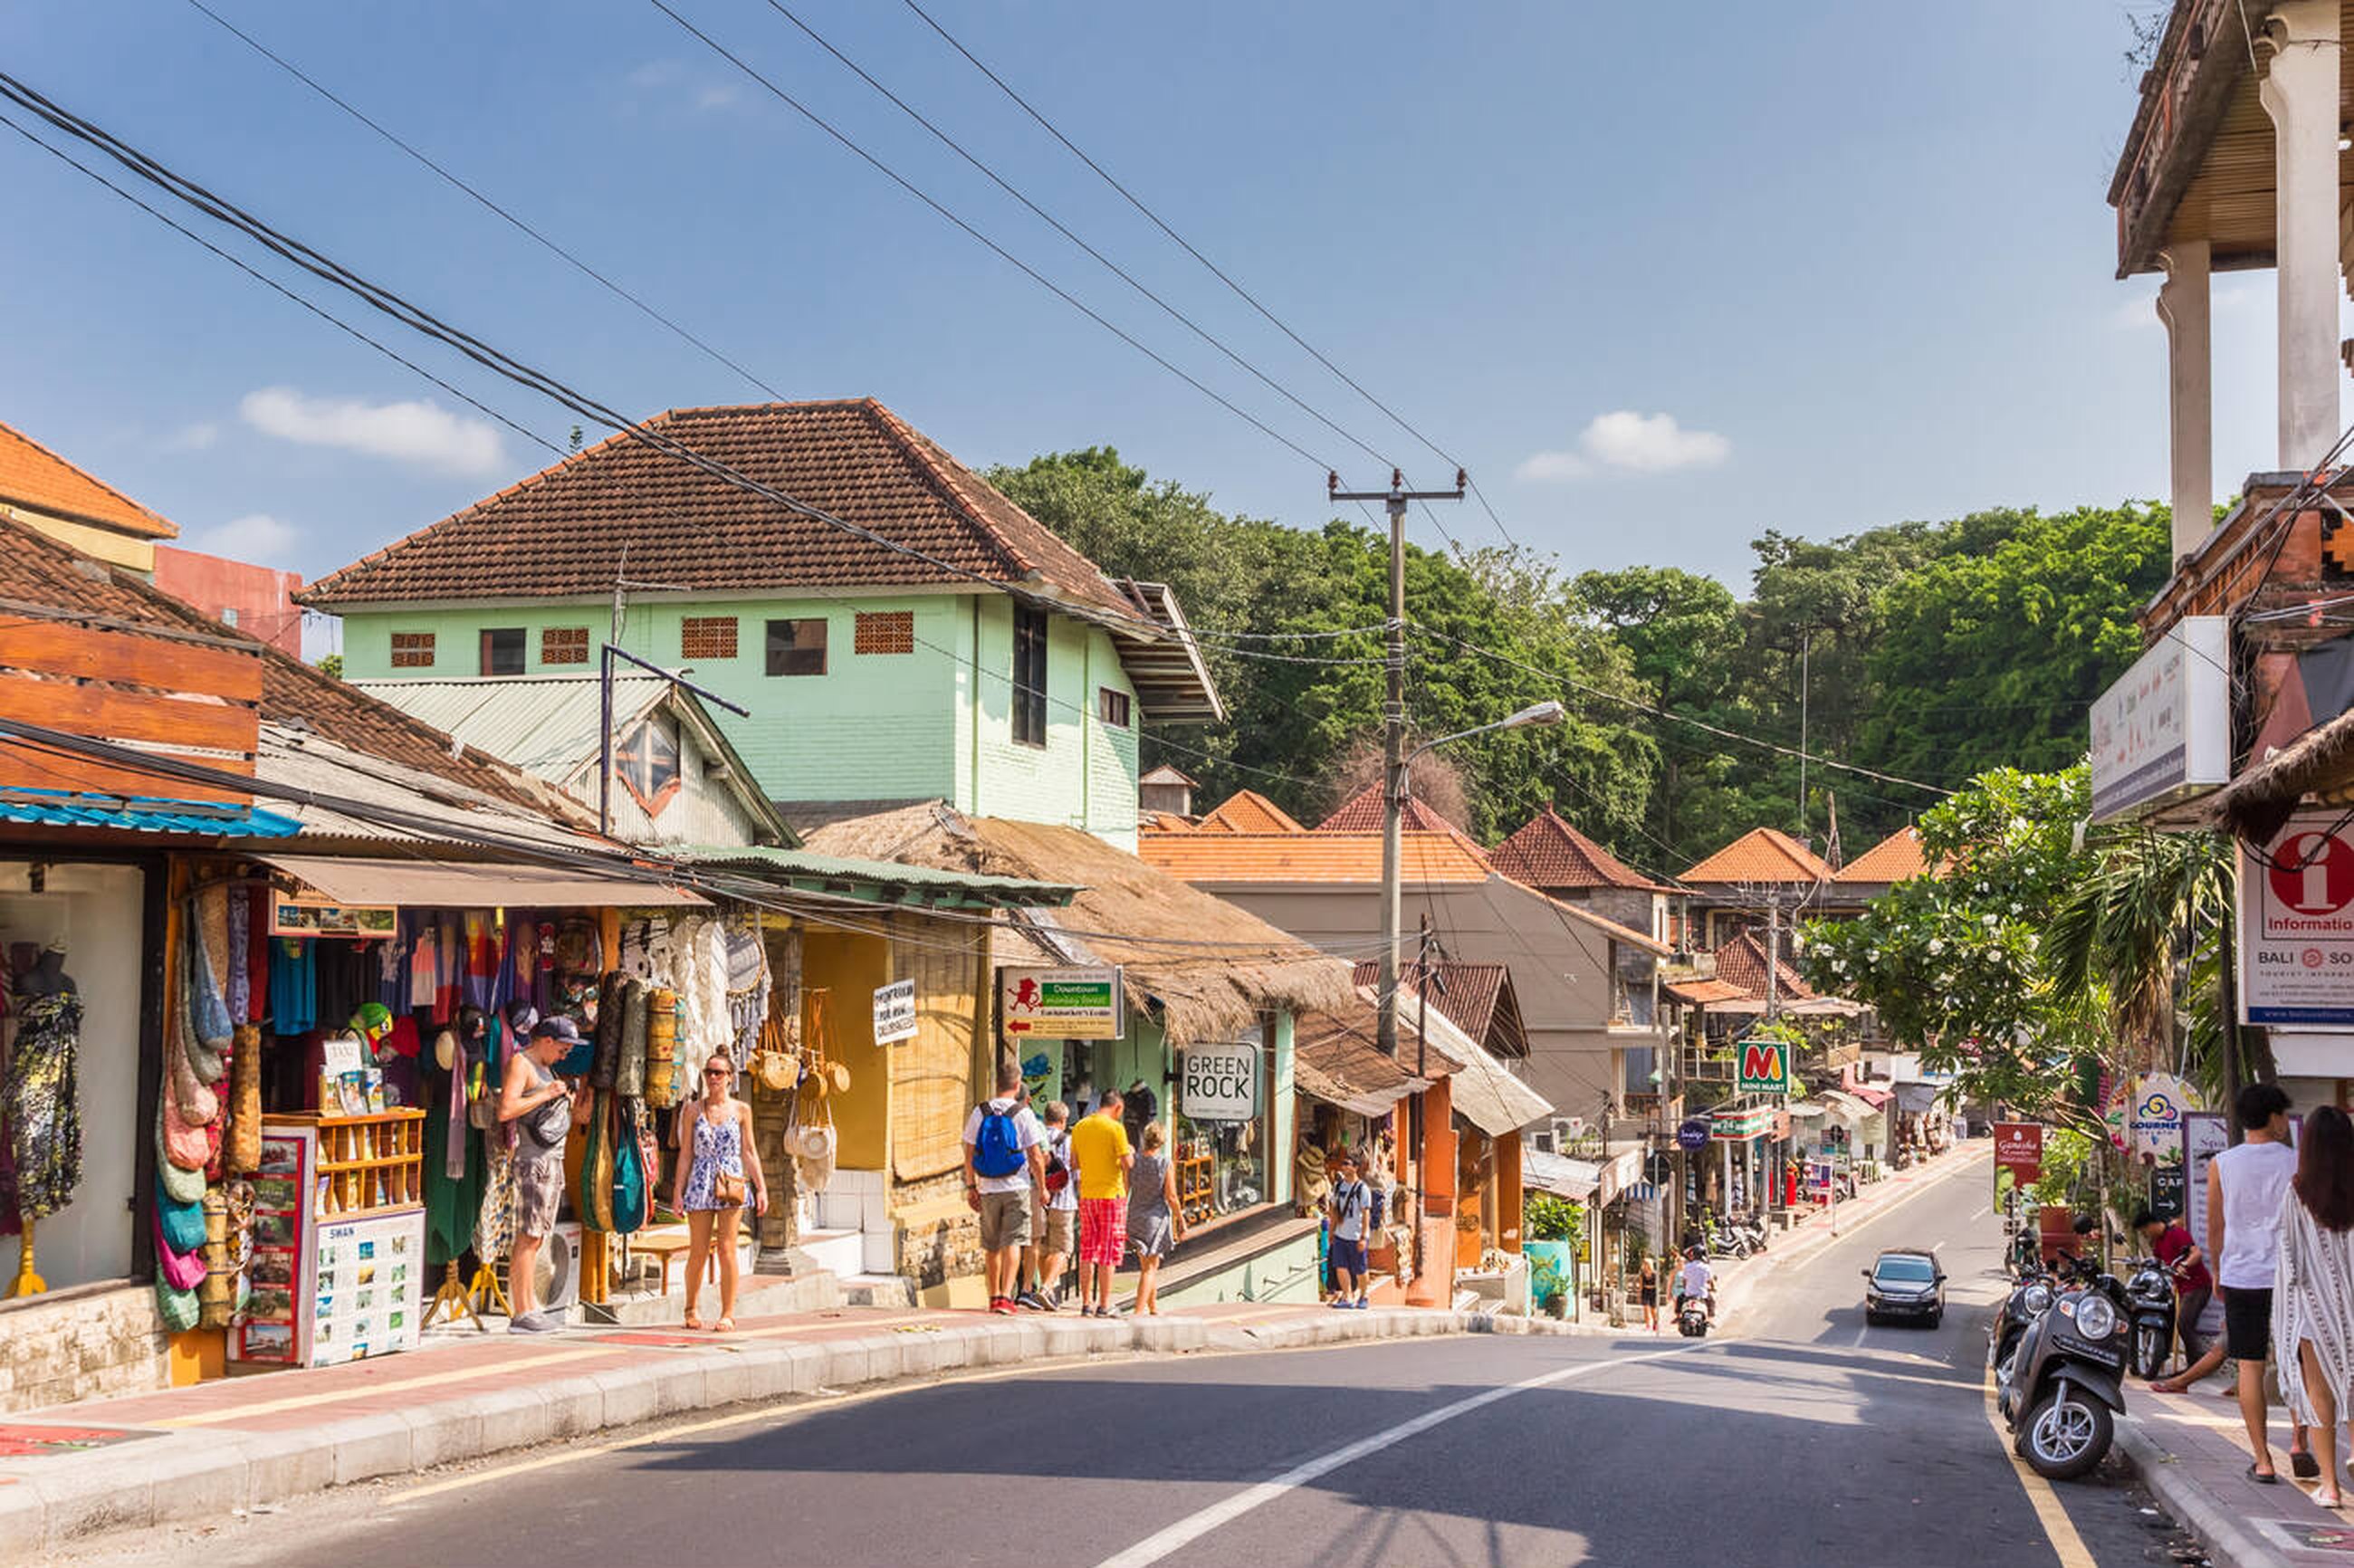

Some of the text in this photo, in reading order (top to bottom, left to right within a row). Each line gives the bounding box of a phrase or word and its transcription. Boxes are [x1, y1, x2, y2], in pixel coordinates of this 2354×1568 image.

[2258, 951, 2293, 964] BALI
[1187, 1056, 1249, 1075] GREEN
[1187, 1076, 1249, 1099] ROCK
[1761, 1083, 1785, 1092] MART
